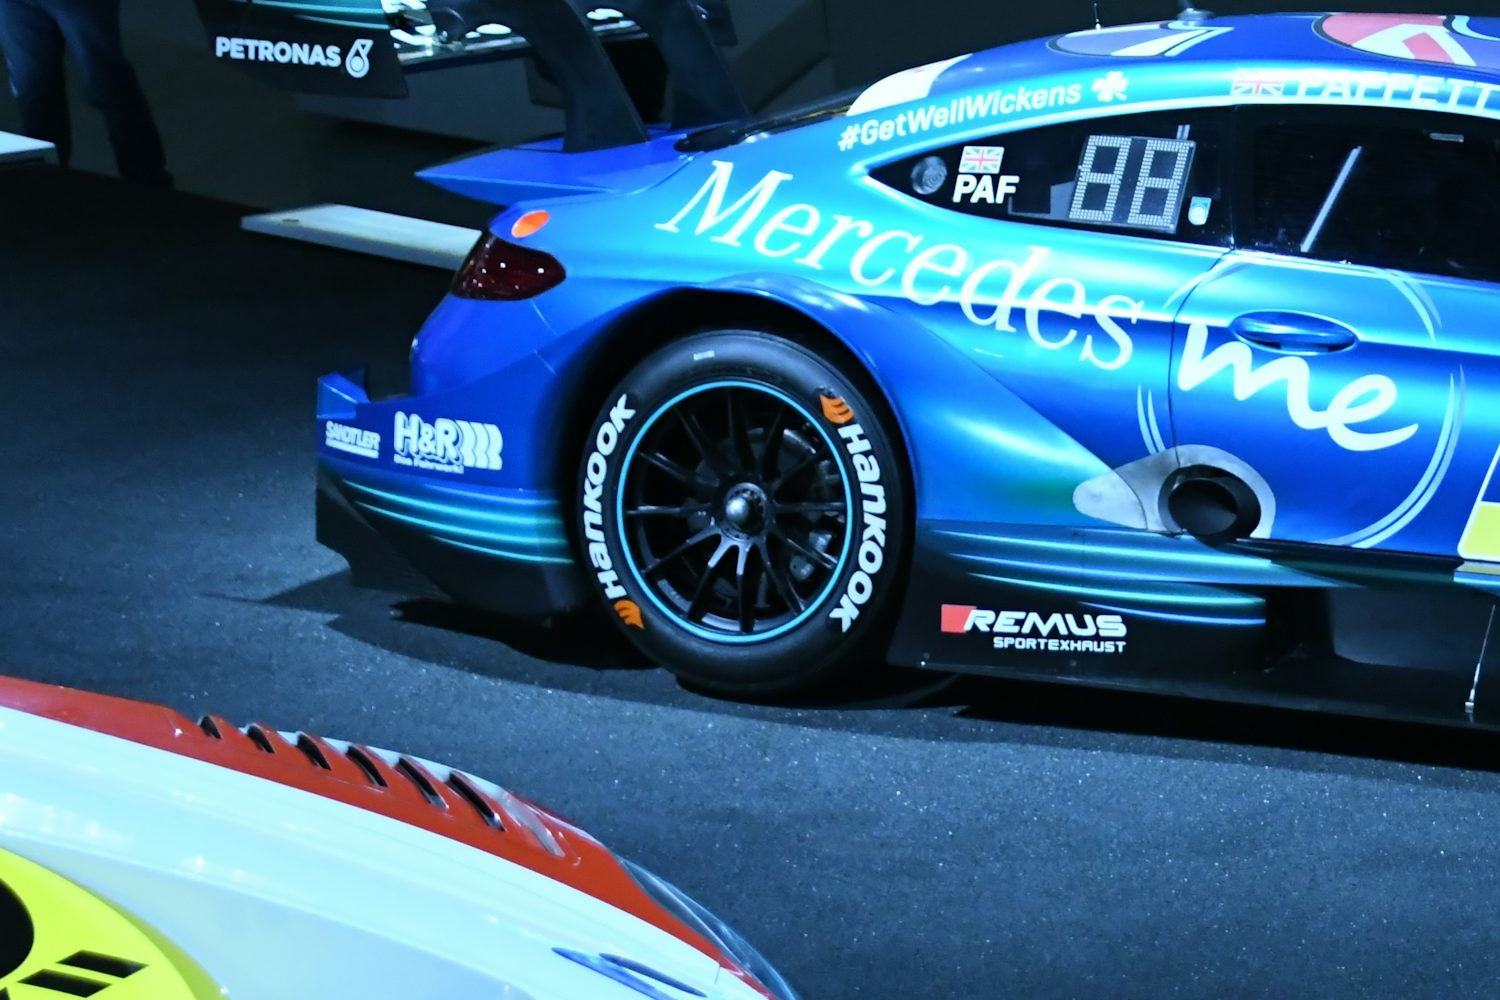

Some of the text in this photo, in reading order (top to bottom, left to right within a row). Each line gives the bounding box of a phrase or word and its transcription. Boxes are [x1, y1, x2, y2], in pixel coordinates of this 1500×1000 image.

[215, 36, 342, 69] PETRONAS
[838, 83, 1082, 152] #GetWellWickens
[953, 174, 1020, 205] PAF
[655, 160, 1146, 370] Mercedes
[1178, 323, 1419, 452] me
[394, 411, 464, 465] H&R
[963, 609, 1128, 638] REMUS
[993, 636, 1127, 654] SPORTEXHAUST
